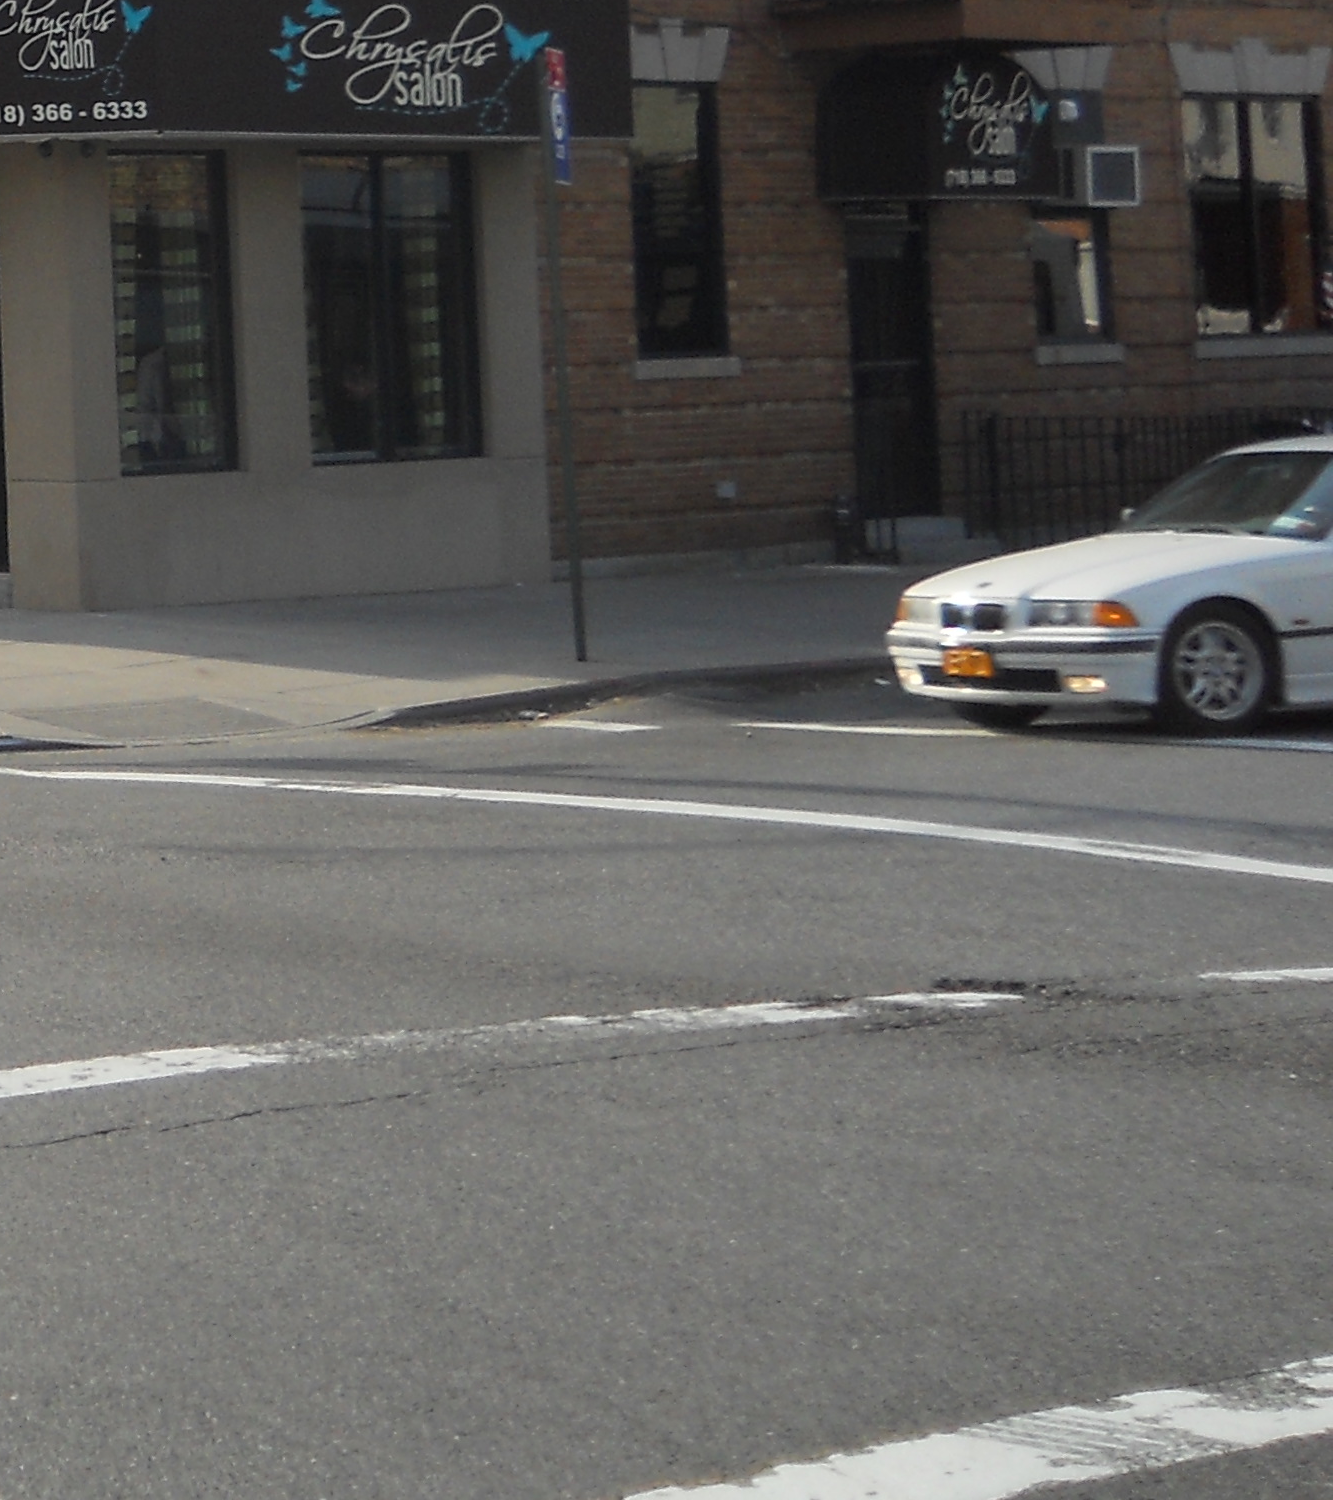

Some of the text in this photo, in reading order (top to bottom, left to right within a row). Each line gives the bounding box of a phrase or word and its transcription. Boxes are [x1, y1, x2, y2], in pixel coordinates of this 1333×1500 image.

[50, 32, 95, 70] salon
[300, 4, 504, 104] Chrysalis
[394, 63, 463, 108] salon
[32, 103, 73, 122] 366
[92, 100, 148, 120] 6333
